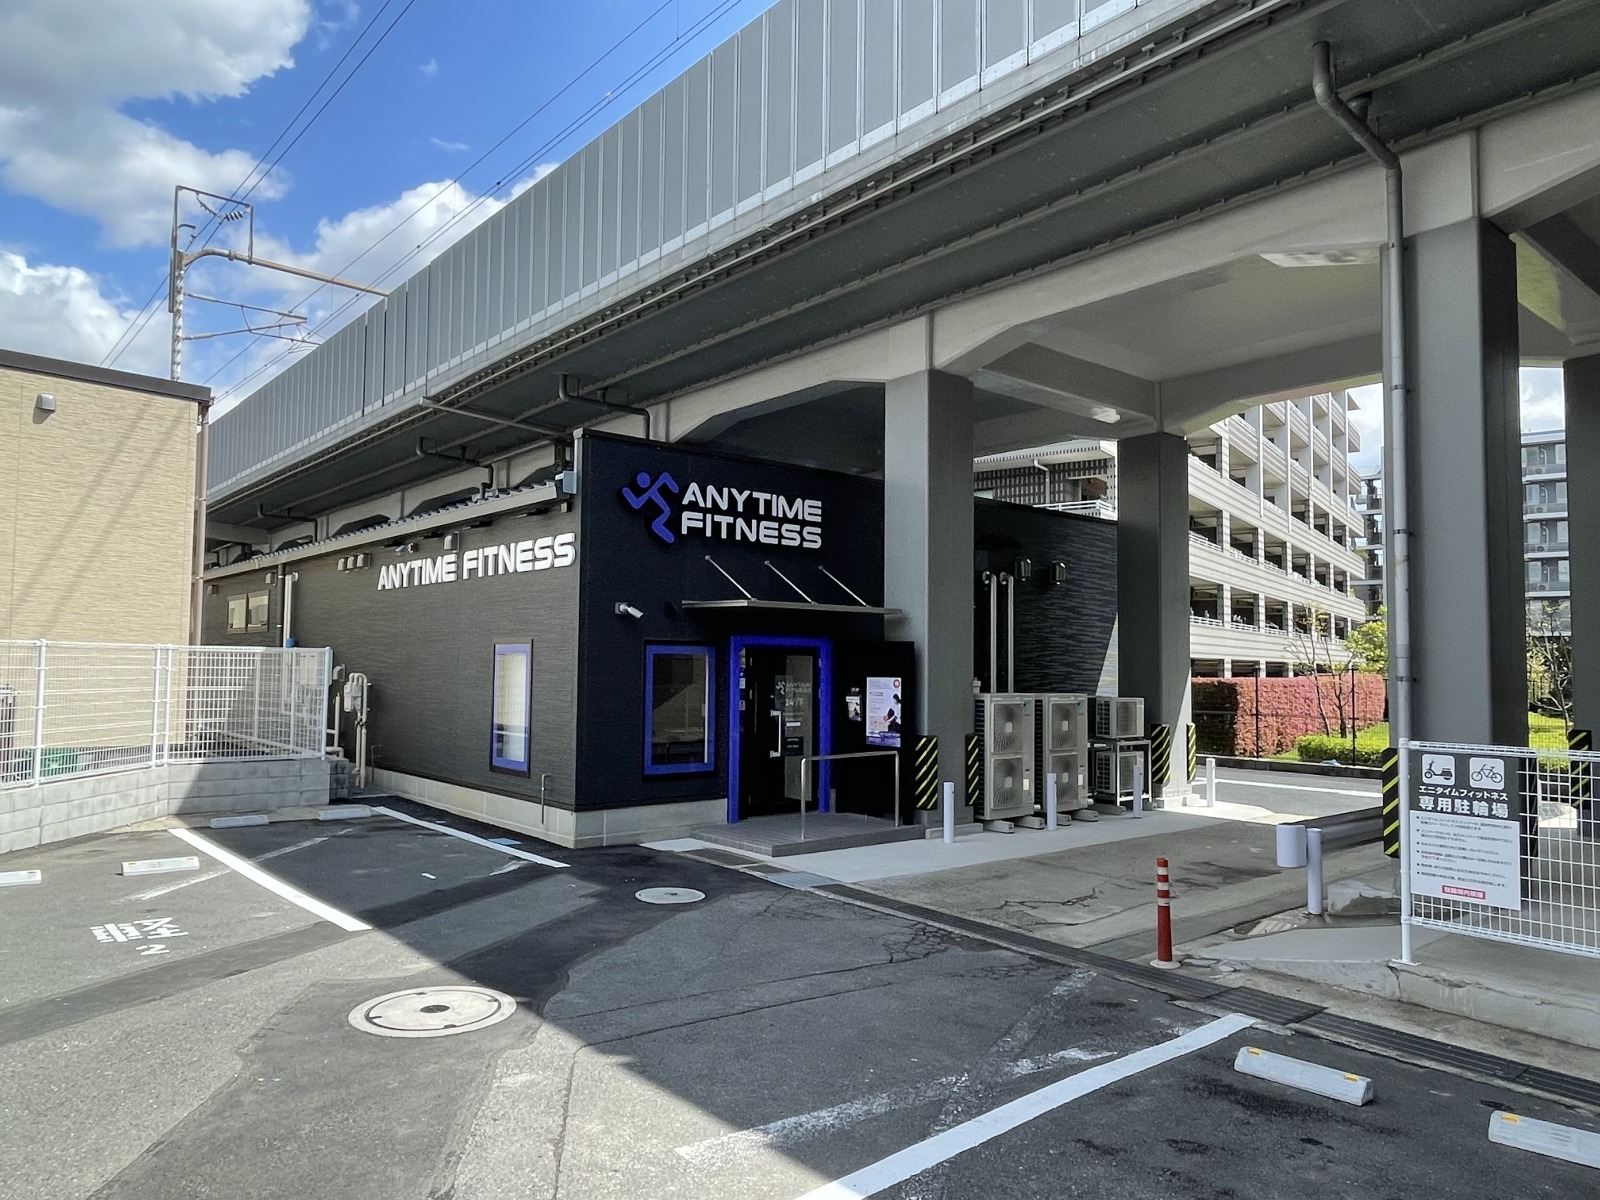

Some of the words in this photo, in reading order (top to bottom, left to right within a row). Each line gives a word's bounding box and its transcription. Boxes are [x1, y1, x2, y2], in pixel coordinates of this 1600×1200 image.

[681, 481, 822, 523] ANYTIME
[681, 510, 822, 549] FITNESS
[377, 553, 458, 591] ANYTIME
[462, 532, 576, 580] FITNESS
[1418, 785, 1509, 801] エニタイムフィットネス
[1418, 795, 1509, 818] 専用駐輪場
[135, 944, 170, 956] 2
